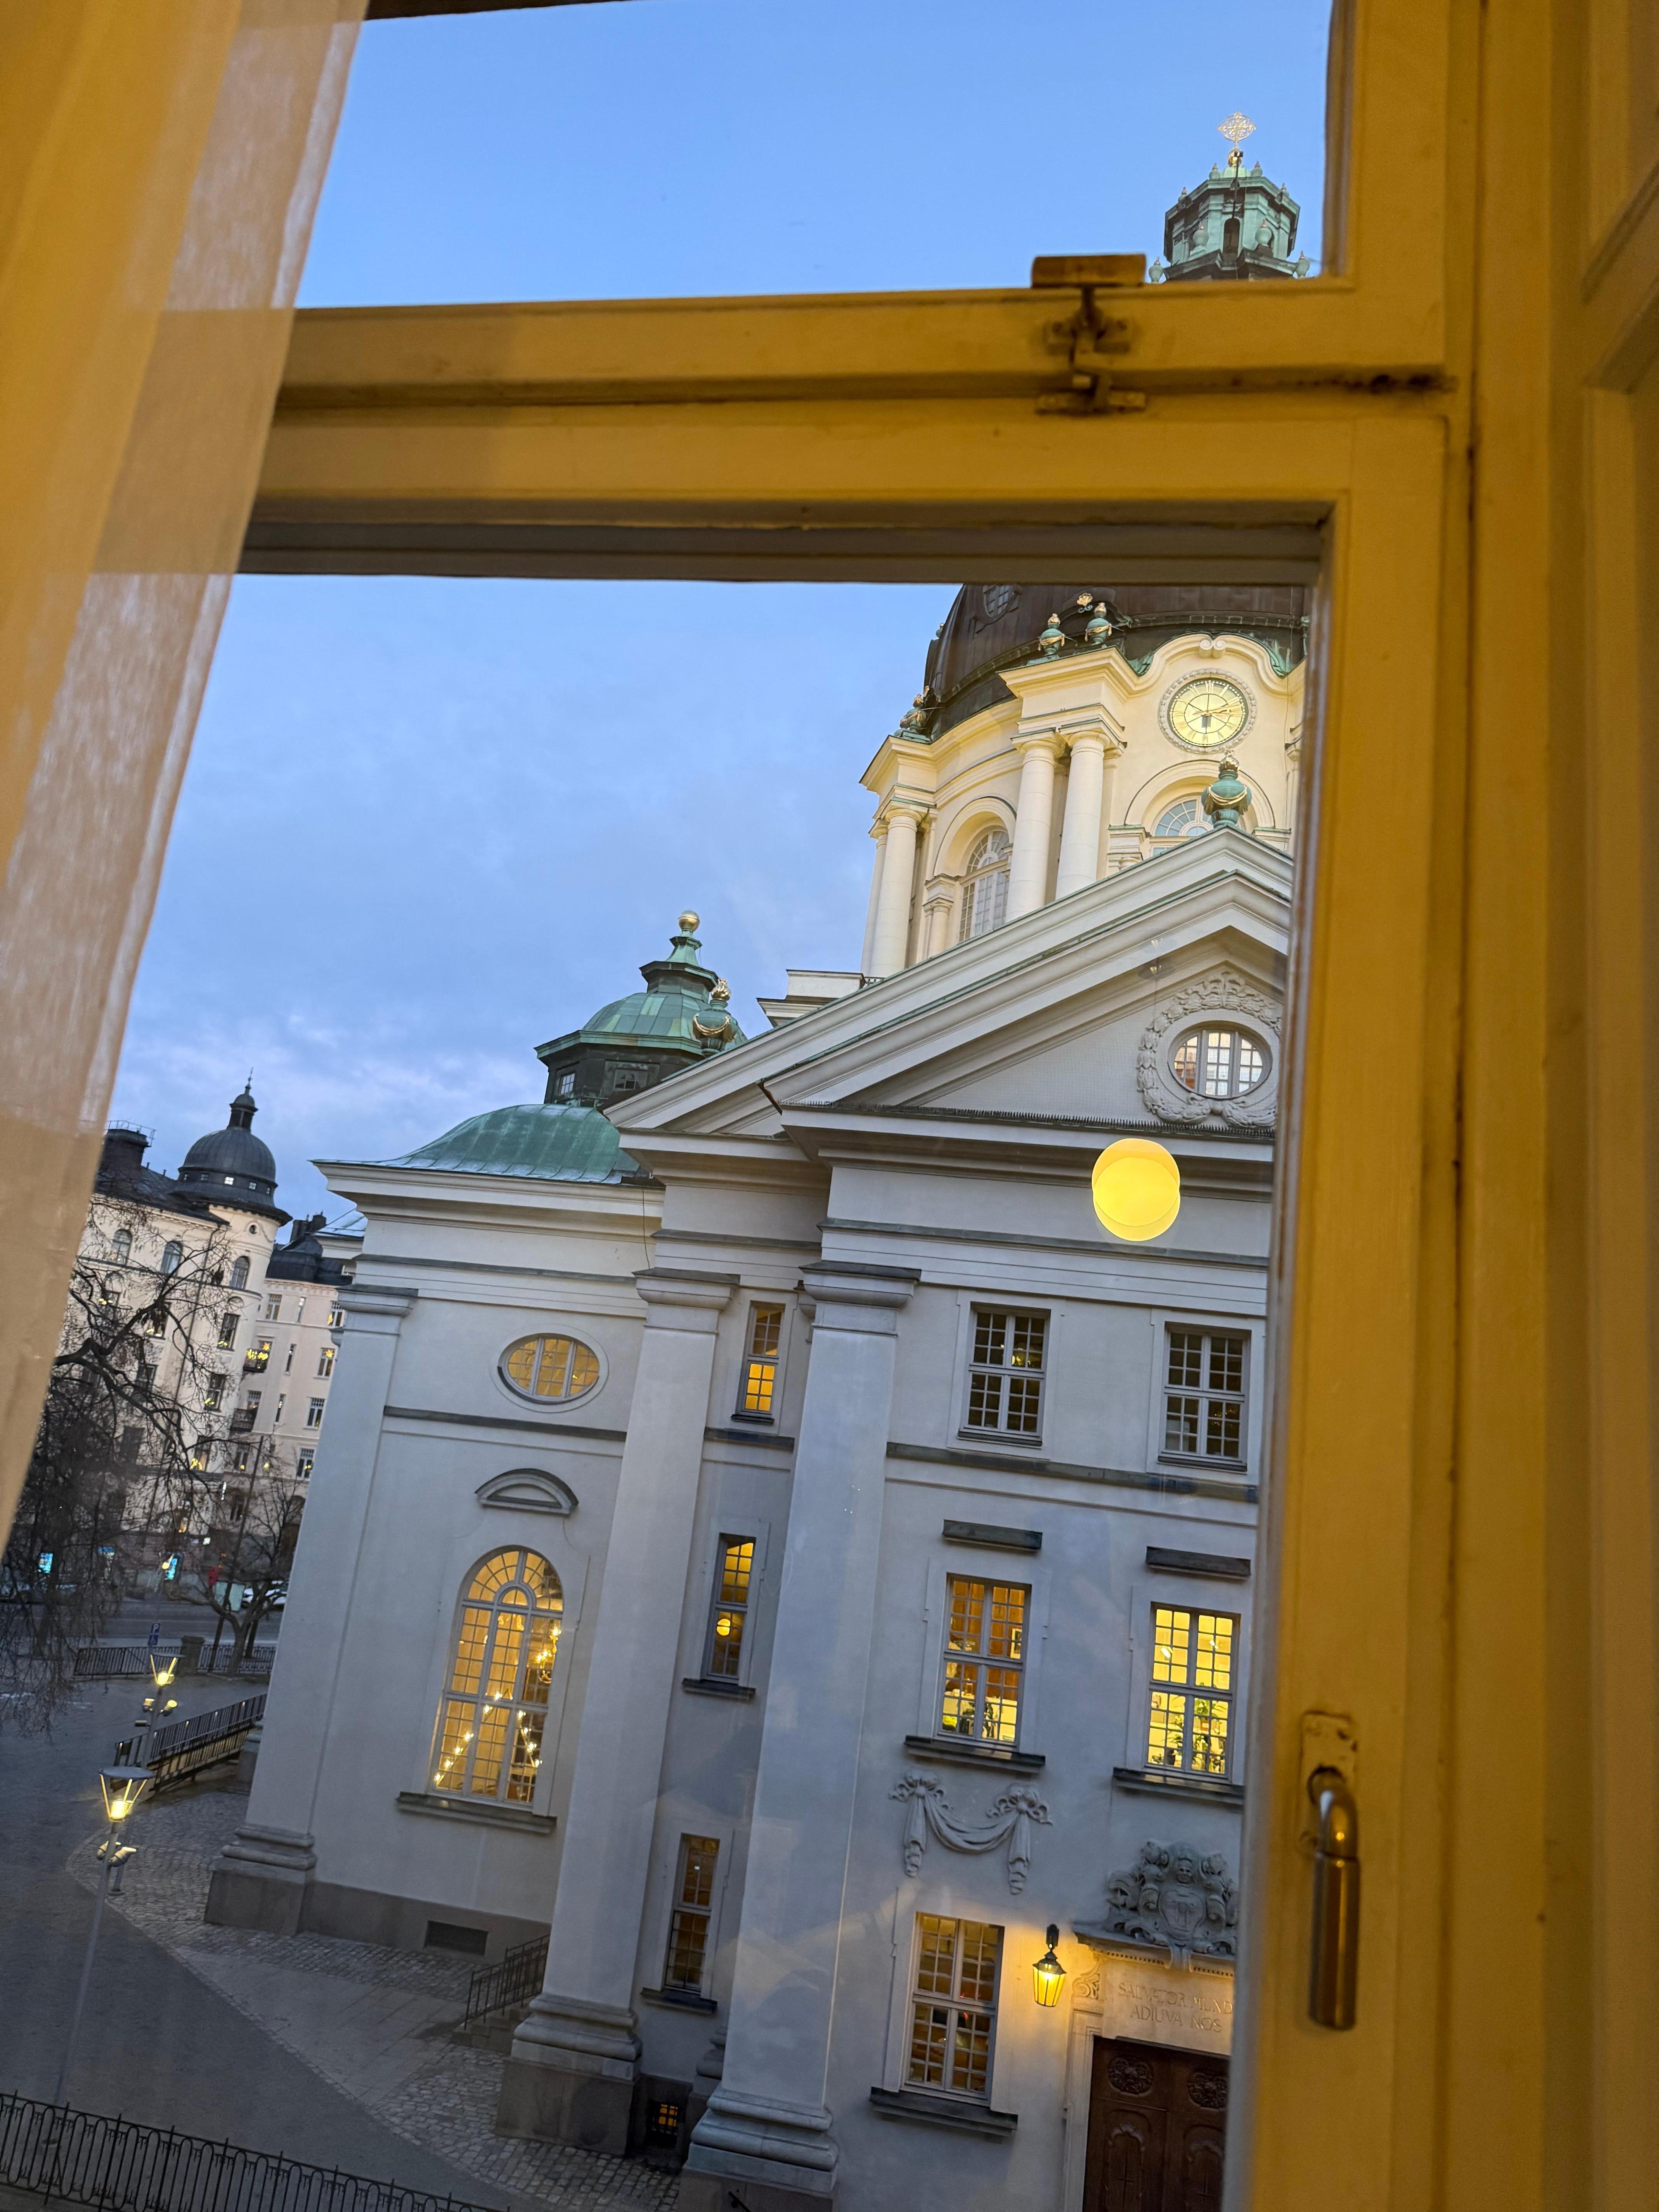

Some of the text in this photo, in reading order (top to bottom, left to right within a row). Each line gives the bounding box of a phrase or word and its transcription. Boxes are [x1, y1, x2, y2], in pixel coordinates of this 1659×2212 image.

[153, 1623, 159, 1633] P
[1118, 1982, 1187, 2008] SALVATOR
[1130, 2004, 1222, 2033] ADIUVA NOS
